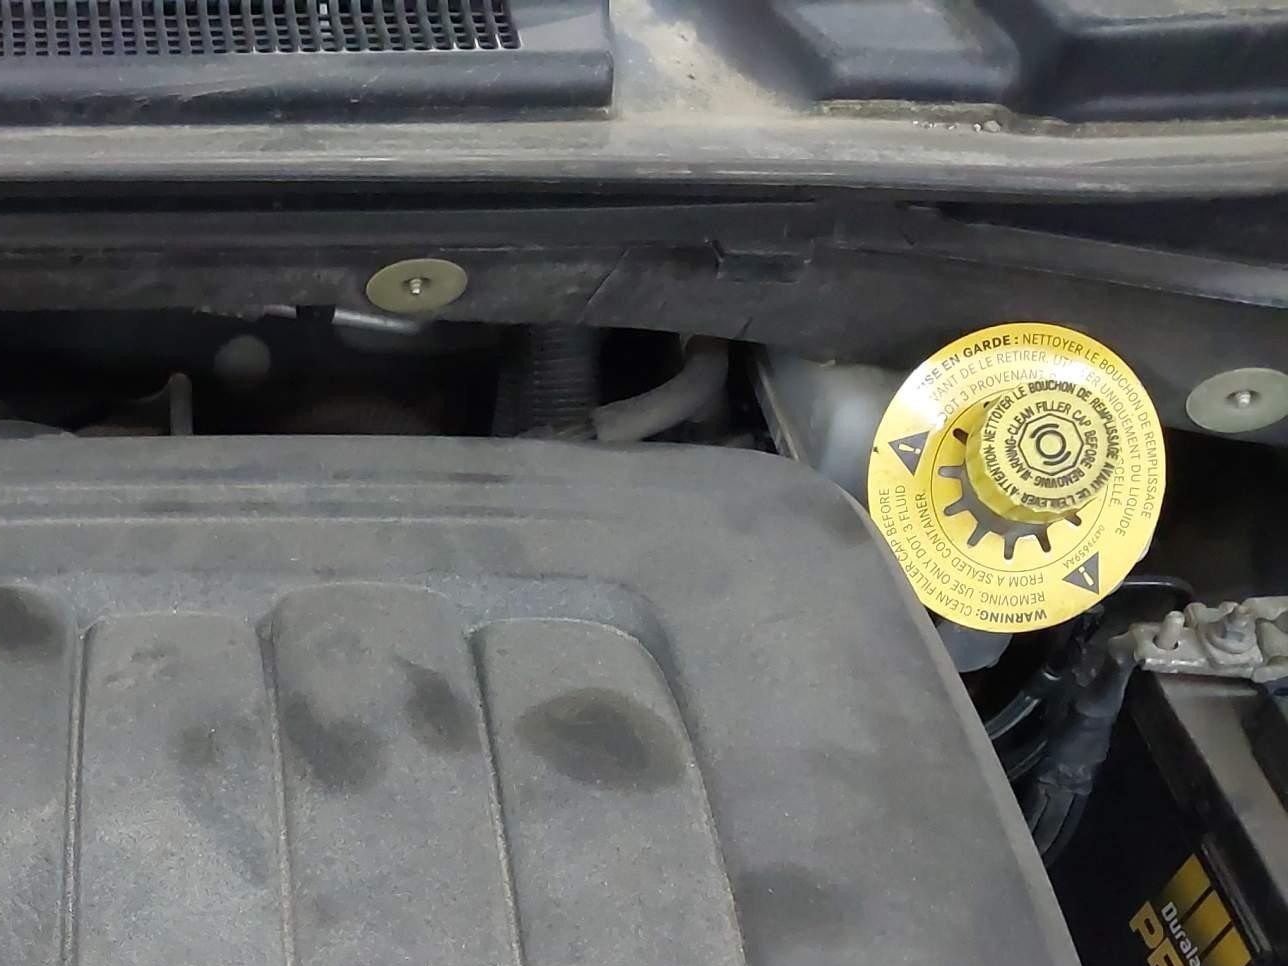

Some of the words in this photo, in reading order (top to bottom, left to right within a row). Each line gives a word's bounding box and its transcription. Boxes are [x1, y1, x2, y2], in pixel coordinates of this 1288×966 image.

[963, 335, 1011, 358] GARDE
[1022, 333, 1084, 356] NETTOYER
[941, 353, 961, 372] EN
[978, 355, 993, 370] LE
[1084, 349, 1101, 364] LE
[959, 364, 977, 380] DE
[929, 374, 959, 401] VANT
[1012, 385, 1028, 400] LE
[1027, 379, 1076, 394] BOUCHON
[1076, 387, 1092, 402] DE
[1099, 358, 1145, 411] BOUCHON
[959, 390, 970, 401] 3
[1035, 400, 1072, 415] FILLER
[1072, 409, 1092, 426] CAP
[983, 395, 1015, 442] NETTOYER
[1089, 397, 1120, 460] REMPLISSAGE
[1100, 384, 1141, 460] UNIQUEMENT
[1137, 411, 1152, 430] DE
[1080, 429, 1098, 469] BEFORE
[1033, 467, 1086, 488] REMOVING
[1089, 461, 1115, 491] AVANT
[1130, 464, 1142, 482] DU
[1140, 431, 1159, 519] REMPLISSAGE
[878, 488, 897, 537] BEFORE
[895, 484, 911, 520] FLUID
[1114, 487, 1140, 536] LIQUIDE
[903, 524, 913, 533] 3
[914, 489, 952, 559] CONTAINER.
[891, 541, 909, 562] CAP
[906, 535, 927, 559] DOT
[904, 562, 937, 595] FILLER
[923, 559, 951, 585] ONLY
[951, 558, 993, 584] SEALED
[997, 575, 1005, 585] A
[1008, 573, 1044, 588] FROM
[950, 584, 975, 599] USE
[978, 591, 1045, 607] REMOVING.
[936, 590, 973, 616] CLEAN
[975, 609, 1047, 623] WARNING:
